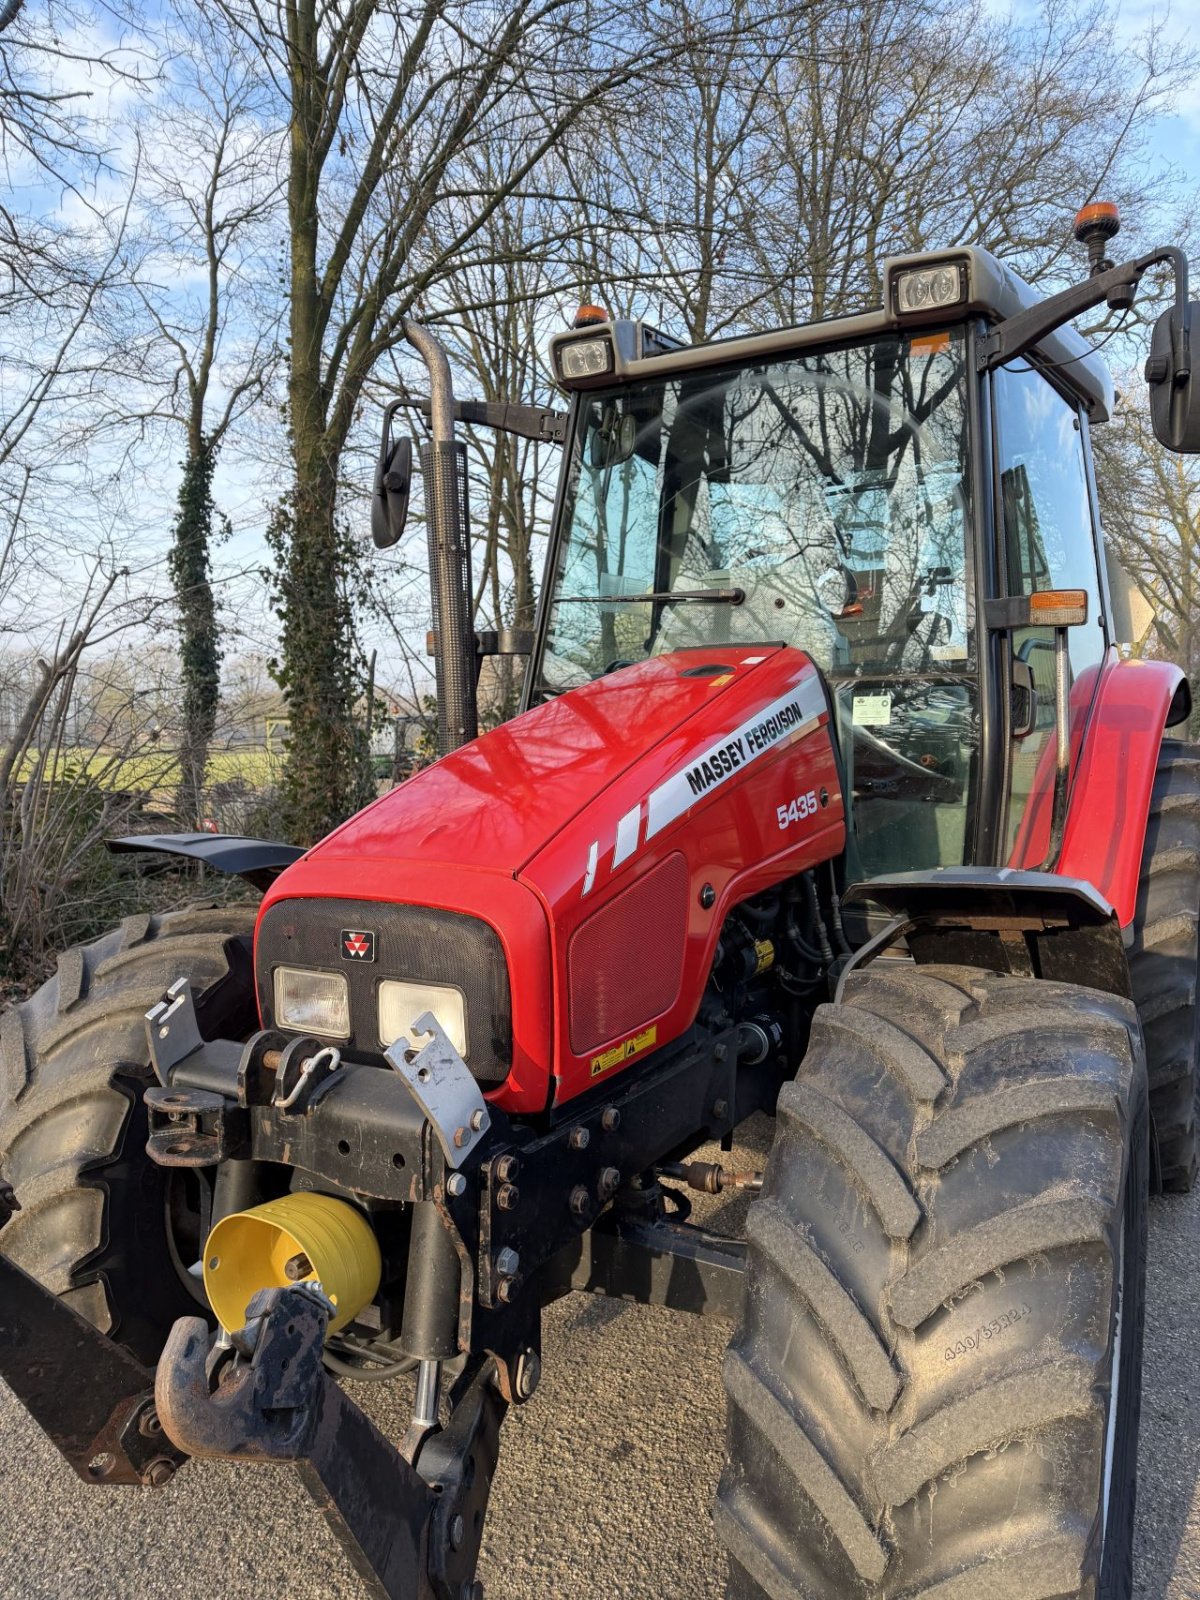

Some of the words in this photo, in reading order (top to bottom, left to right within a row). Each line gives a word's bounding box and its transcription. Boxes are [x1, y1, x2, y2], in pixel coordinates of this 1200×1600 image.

[684, 738, 746, 796] MASSEY
[744, 702, 803, 754] FERGUSON
[776, 790, 818, 830] 5435
